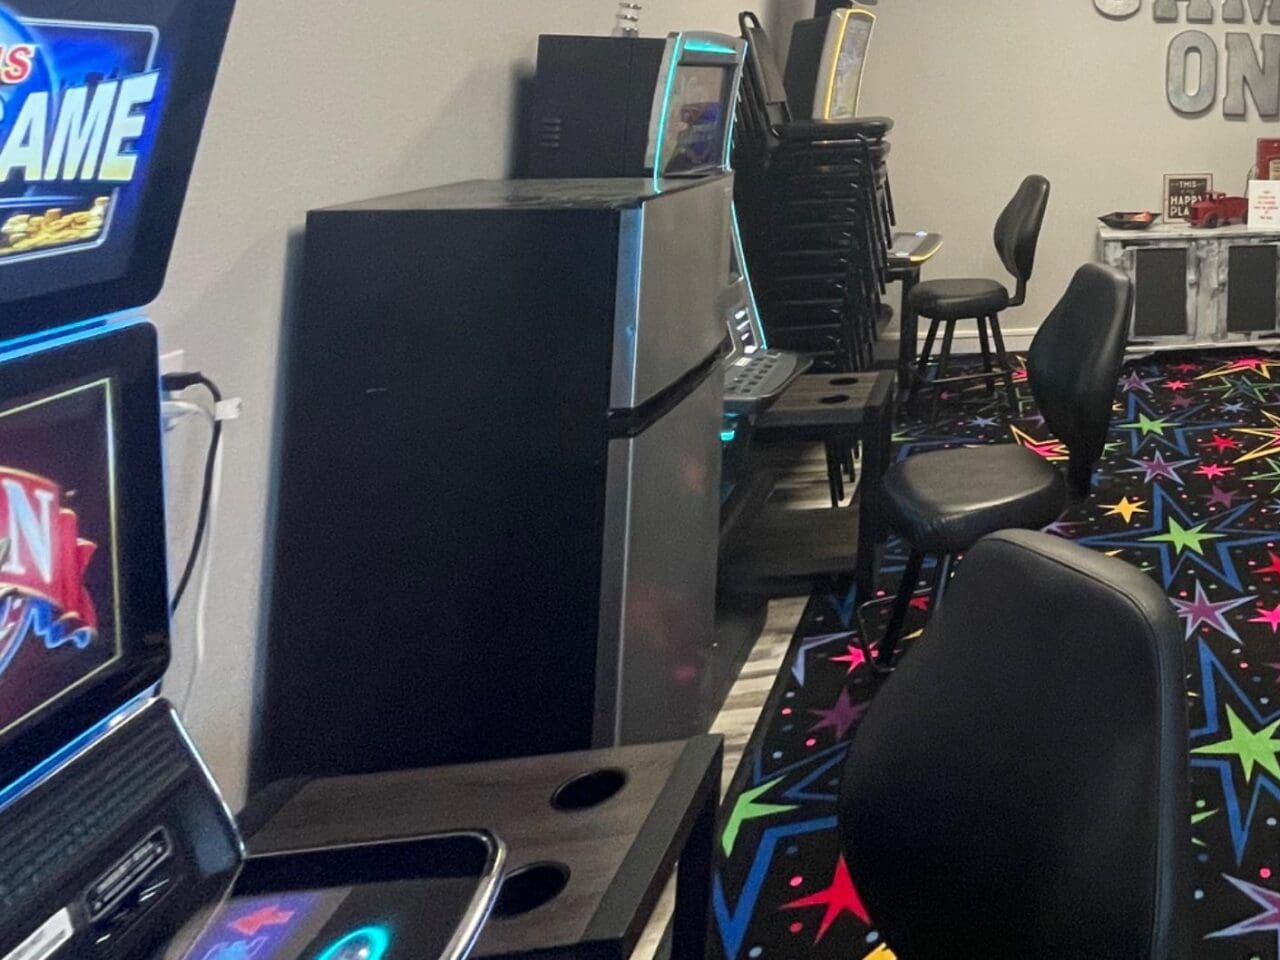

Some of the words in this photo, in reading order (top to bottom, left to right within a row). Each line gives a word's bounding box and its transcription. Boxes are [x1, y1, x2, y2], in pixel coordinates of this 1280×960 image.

[0, 45, 34, 83] S
[0, 73, 159, 183] AME
[1180, 180, 1197, 188] THIS
[1170, 206, 1190, 217] PLA
